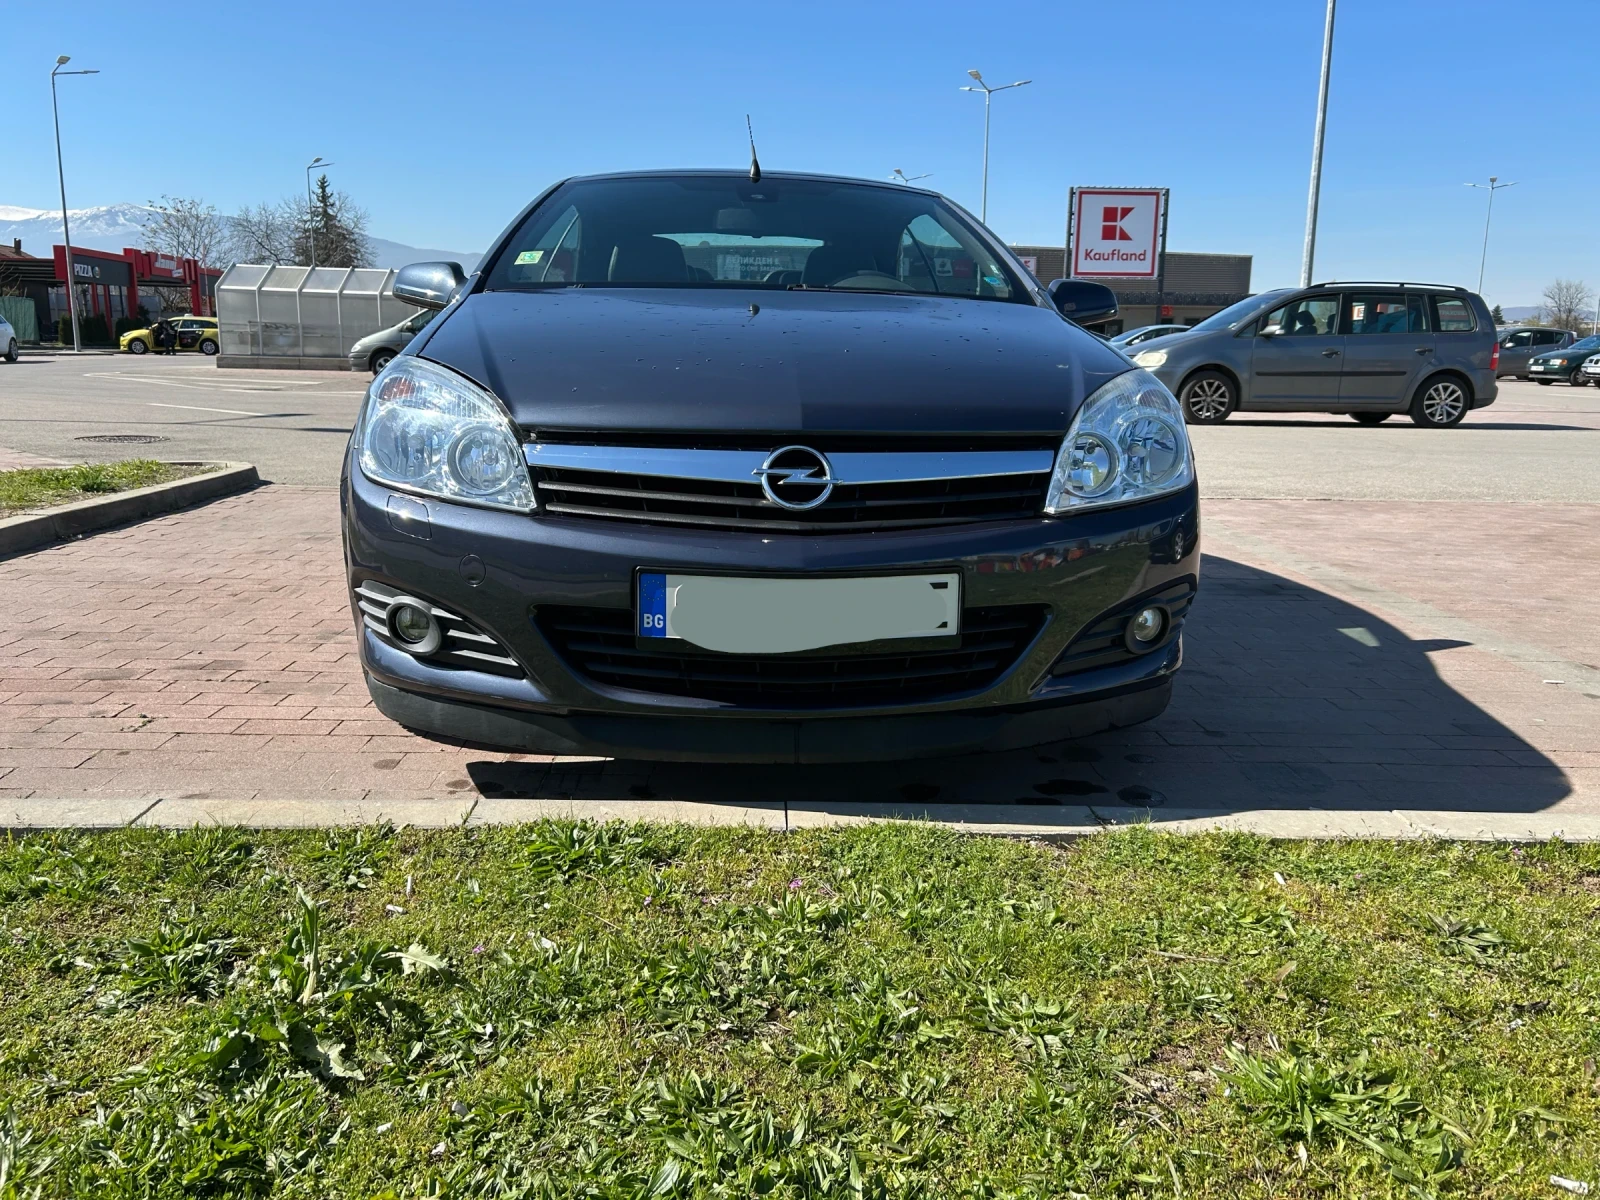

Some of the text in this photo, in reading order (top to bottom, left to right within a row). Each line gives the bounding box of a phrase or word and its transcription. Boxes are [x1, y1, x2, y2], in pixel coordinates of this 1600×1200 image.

[1084, 248, 1147, 261] Kaufland
[73, 263, 93, 277] PIZZA
[643, 613, 664, 628] BG
